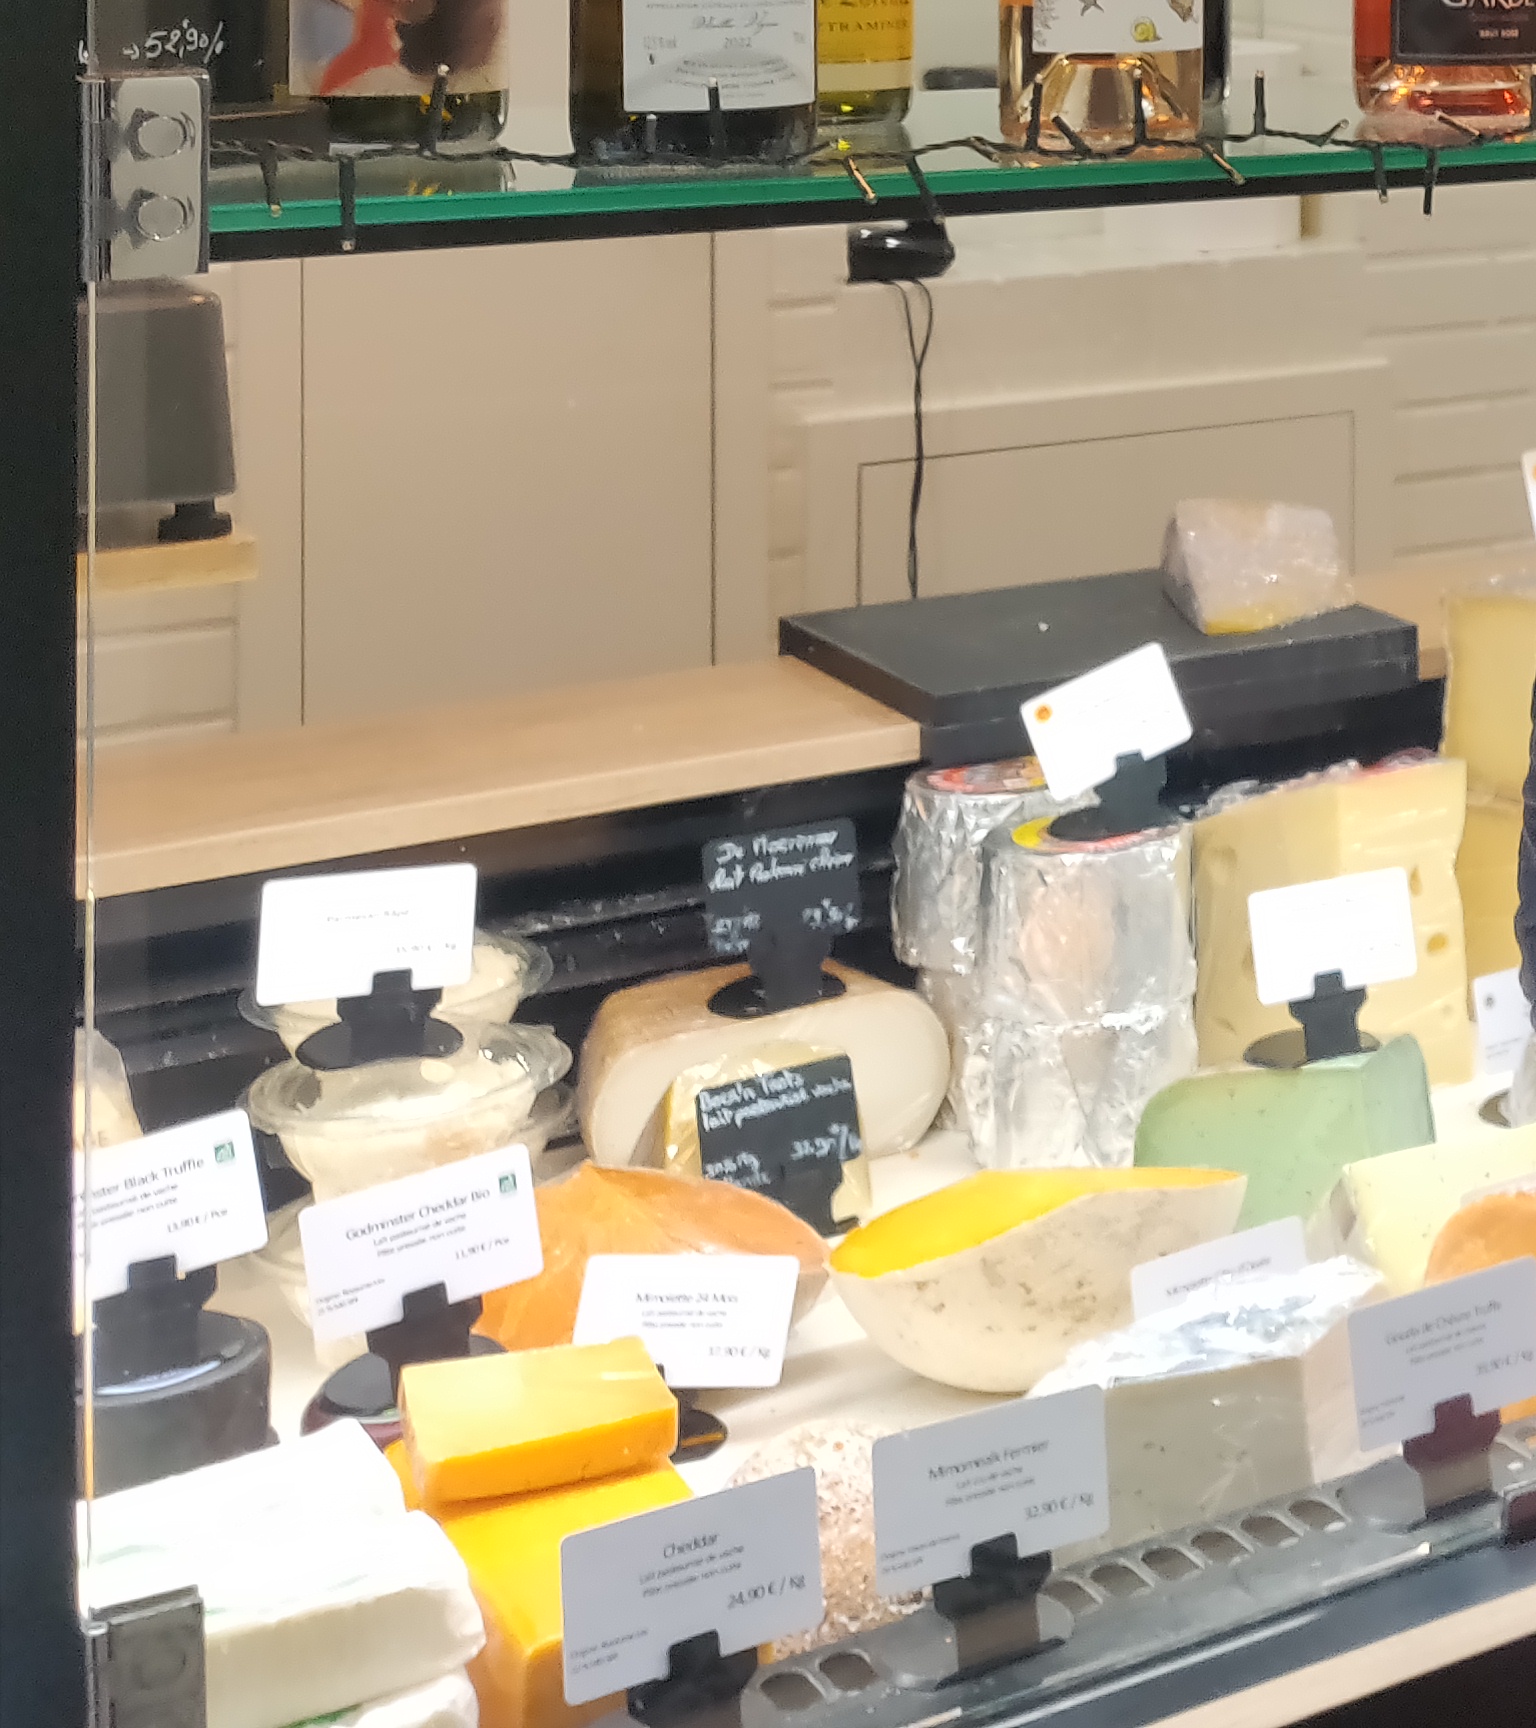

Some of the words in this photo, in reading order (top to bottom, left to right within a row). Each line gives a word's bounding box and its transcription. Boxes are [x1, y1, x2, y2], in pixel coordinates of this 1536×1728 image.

[124, 1170, 159, 1191] Black
[162, 1157, 205, 1179] Truffle
[345, 1209, 416, 1242] Godminster
[418, 1194, 469, 1219] Cheddar
[470, 1188, 491, 1203] Bio
[662, 1531, 722, 1559] Cheddar
